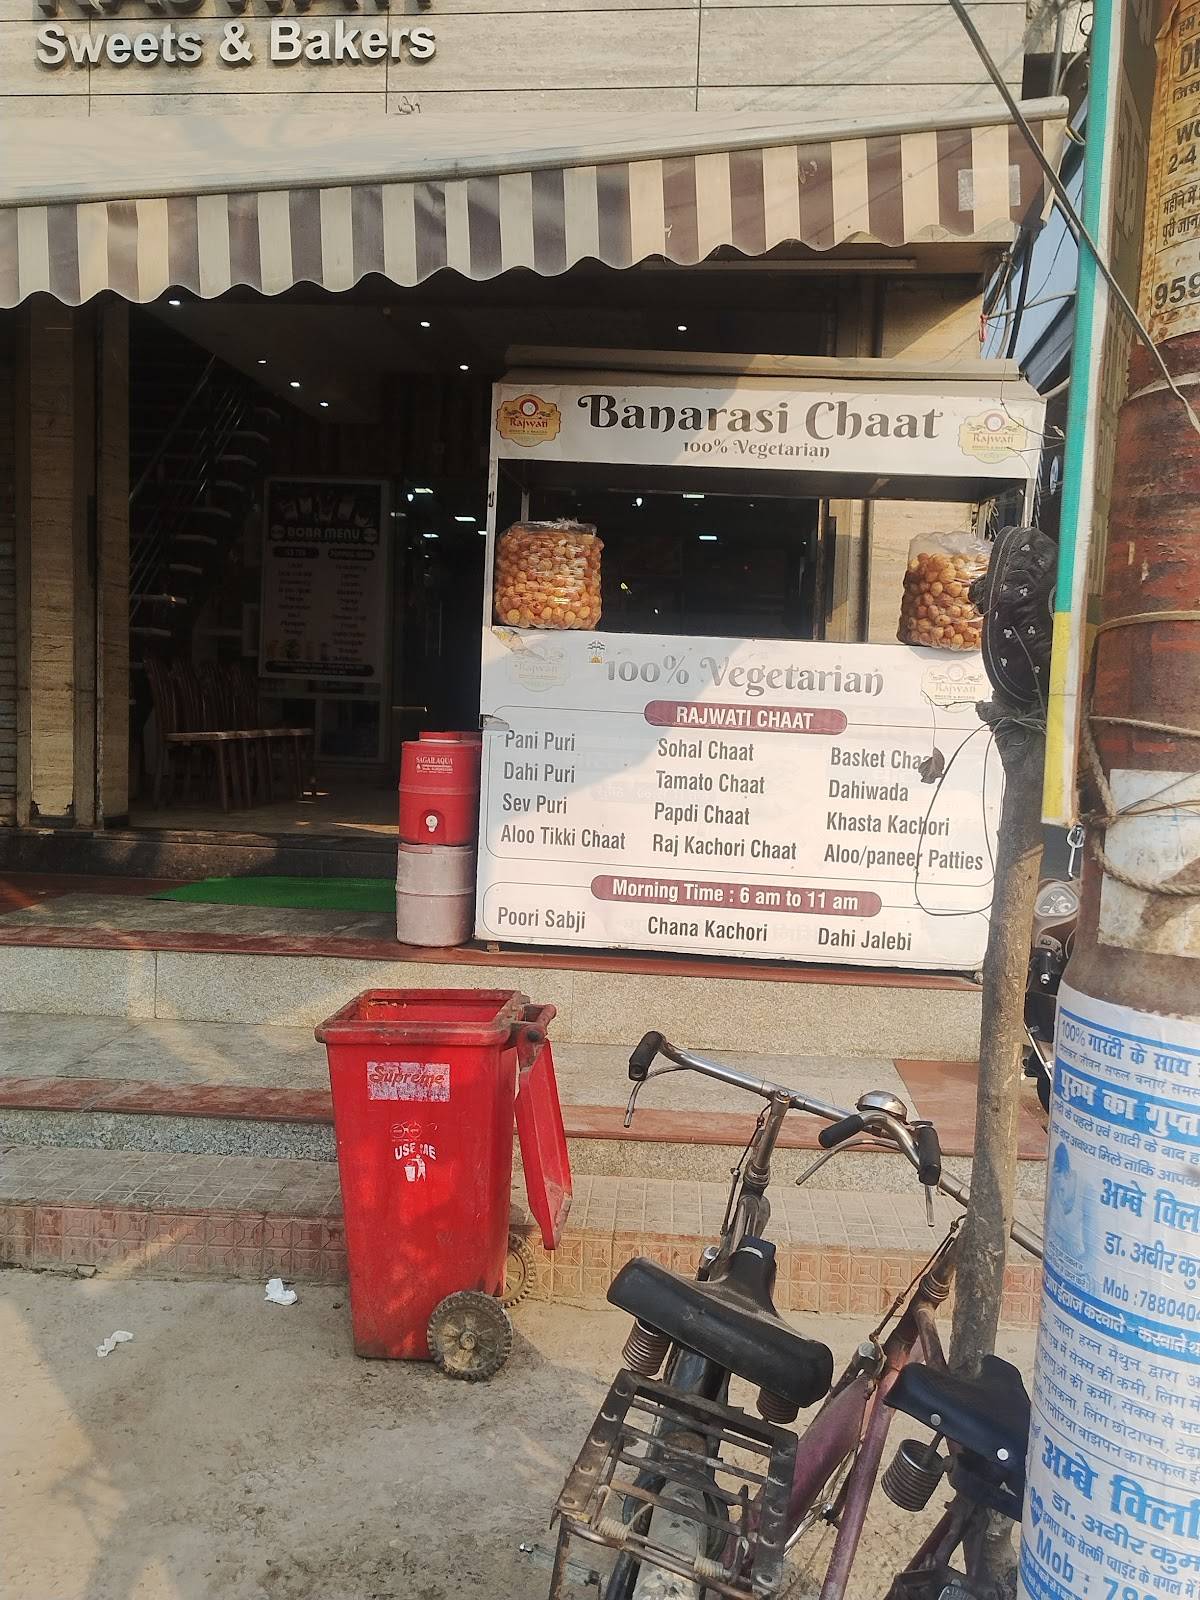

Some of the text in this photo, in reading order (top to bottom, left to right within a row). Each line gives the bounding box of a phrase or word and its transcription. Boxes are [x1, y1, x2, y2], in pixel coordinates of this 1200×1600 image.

[37, 19, 436, 64] Sweets & Bakers
[577, 396, 943, 440] Banarasi Chaat
[683, 440, 830, 459] 100% Vegetarian
[607, 654, 884, 697] 100% Vegetarian
[676, 706, 814, 731] RAJWATI CHAAT
[505, 731, 576, 753] Pani Puri
[658, 739, 754, 763] Sohal Chaat
[831, 747, 885, 770] Basket
[503, 762, 576, 784] Dahi Puri
[656, 771, 765, 794] Tamato Chaat
[829, 779, 909, 803] Dahiwada
[502, 793, 567, 815] Sev Puri
[654, 803, 750, 826] Papdi Chaat
[827, 811, 950, 837] Khasta Kachori
[500, 825, 626, 851] Aloo Tikki Chaat
[652, 834, 797, 861] Raj Kachori Chaat
[824, 843, 984, 871] Aloo/paneer Patties
[612, 879, 858, 911] Morning Time : 6 am to 11 am
[497, 907, 586, 932] Poori Sabji
[647, 917, 767, 943] Chana Kachori
[818, 928, 912, 952] Dahi Jalebi
[1088, 1033, 1124, 1060] गारंटी
[1130, 1043, 1148, 1065] के
[369, 1065, 445, 1087] Supreme
[1102, 1086, 1138, 1121] का
[395, 1142, 416, 1160] USE
[1101, 1178, 1146, 1217] अम्बे
[1103, 1276, 1129, 1301] Mob
[1042, 1435, 1099, 1500] अम्बे
[1036, 1527, 1075, 1584] Mob
